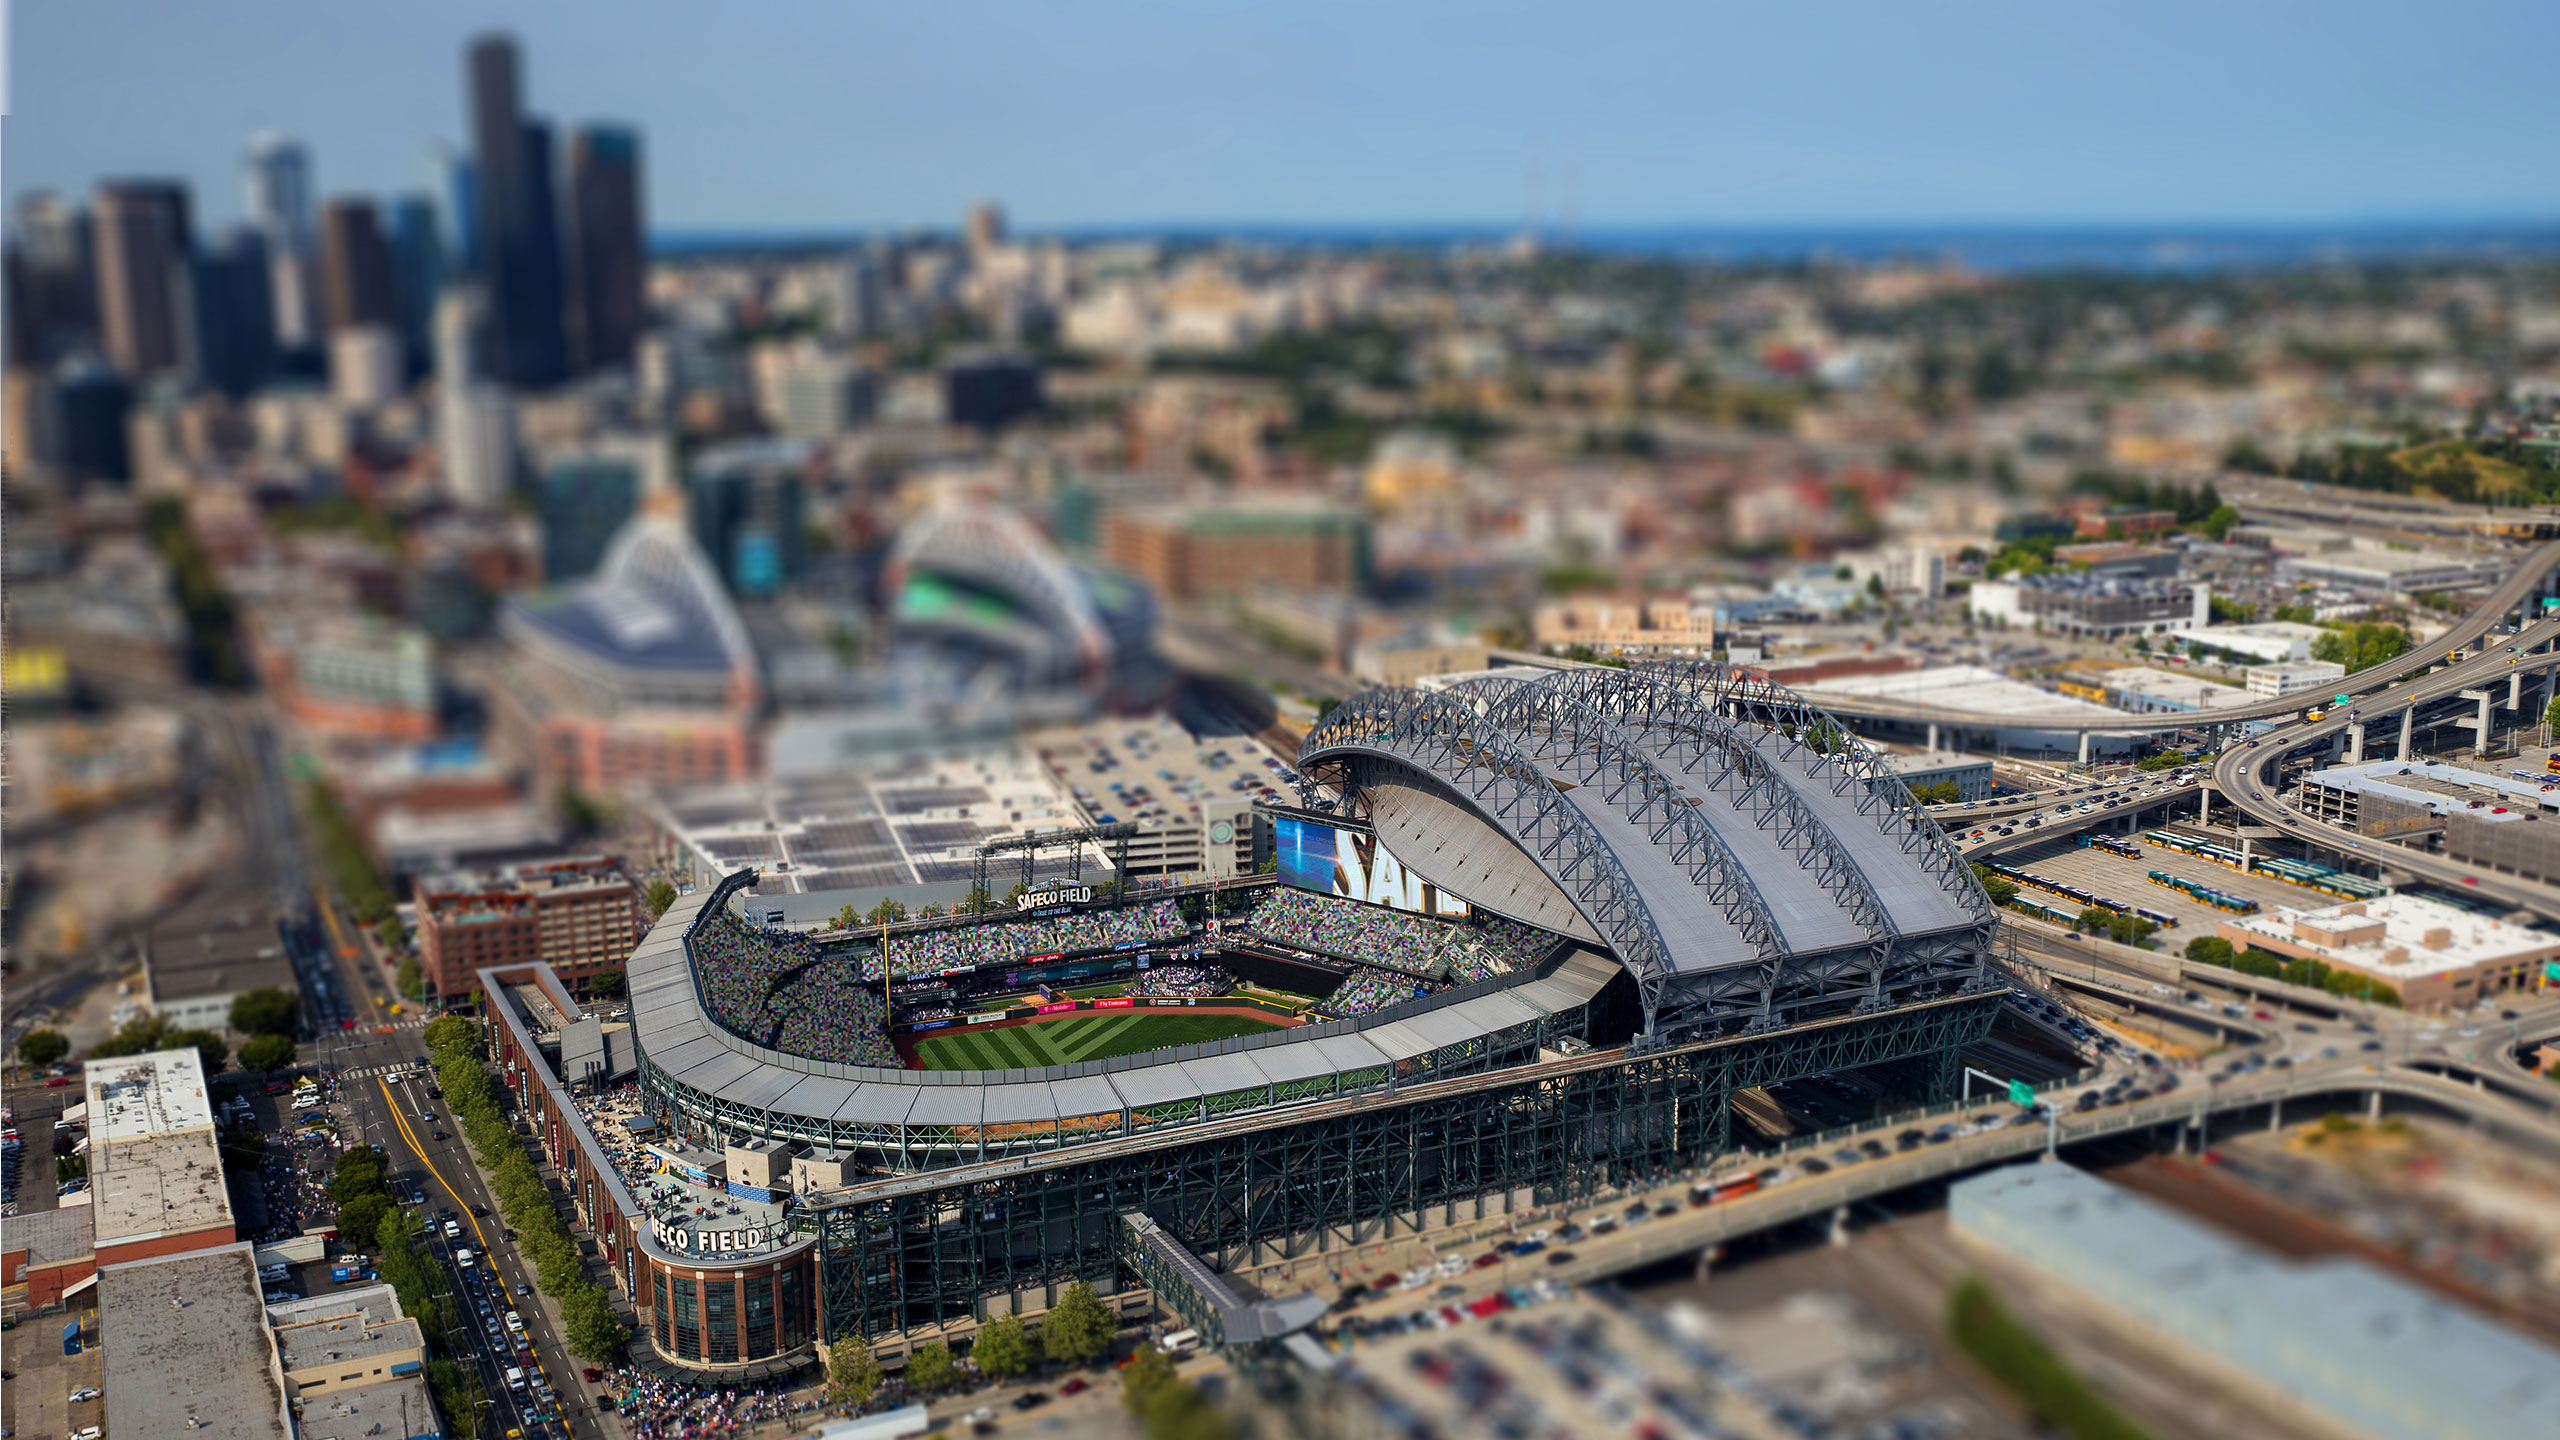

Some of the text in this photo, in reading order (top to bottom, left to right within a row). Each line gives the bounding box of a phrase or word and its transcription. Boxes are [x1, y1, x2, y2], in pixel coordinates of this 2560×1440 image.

[1017, 890, 1058, 912] SAFECO
[1060, 886, 1091, 903] FIELD
[697, 1228, 760, 1252] FIELD
